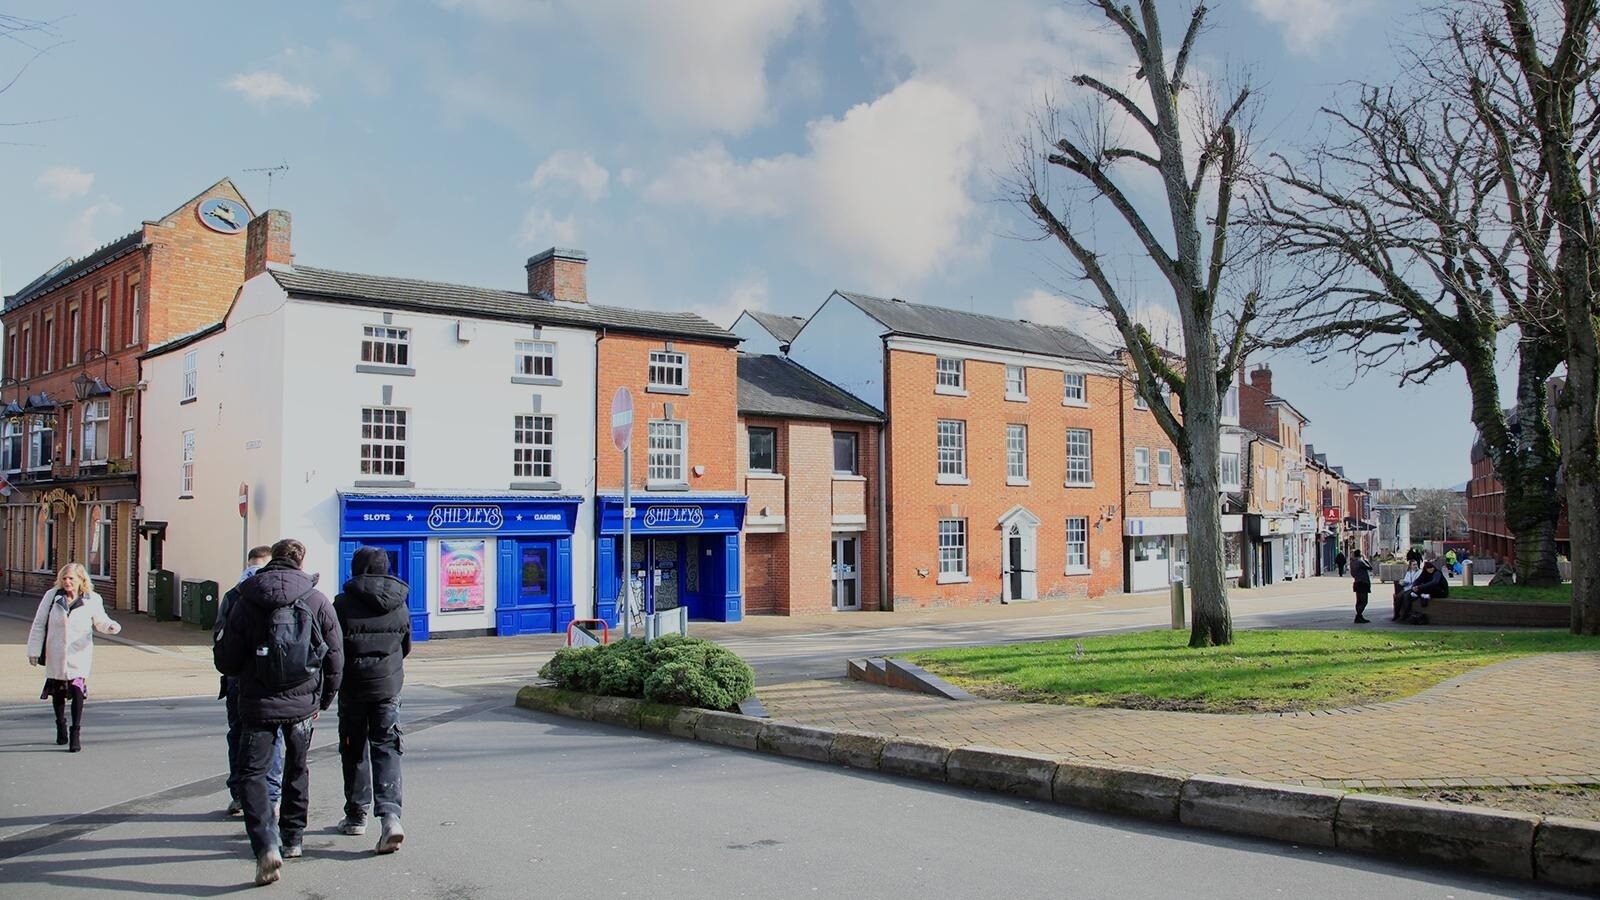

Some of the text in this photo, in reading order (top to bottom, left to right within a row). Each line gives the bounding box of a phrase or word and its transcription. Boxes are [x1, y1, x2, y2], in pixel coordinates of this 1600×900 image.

[363, 513, 391, 521] SLOTS
[432, 508, 500, 527] SHIPLEYS
[647, 508, 702, 525] SHIPLEYS
